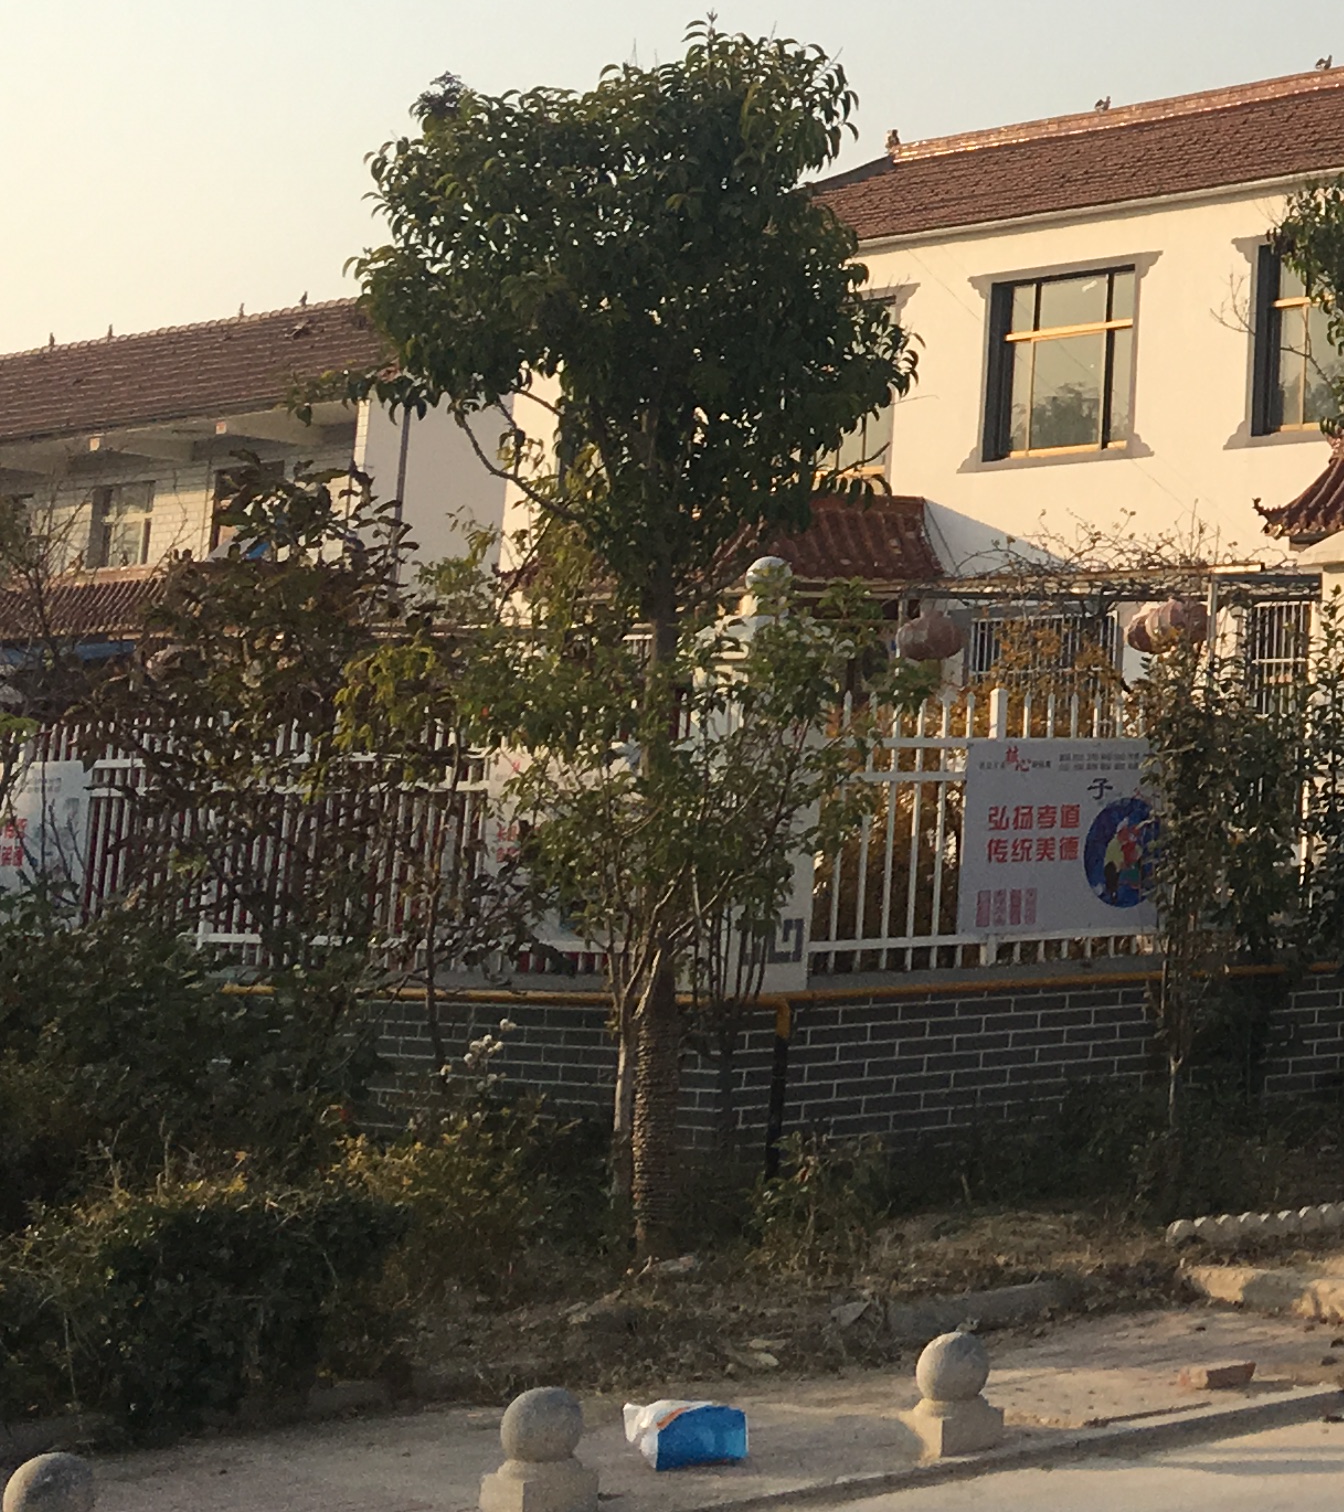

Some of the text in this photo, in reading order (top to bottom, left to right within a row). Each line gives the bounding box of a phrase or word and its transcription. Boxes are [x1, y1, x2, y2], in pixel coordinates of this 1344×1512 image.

[988, 803, 1080, 831] 弘扬孝道
[987, 836, 1079, 863] 传统美德
